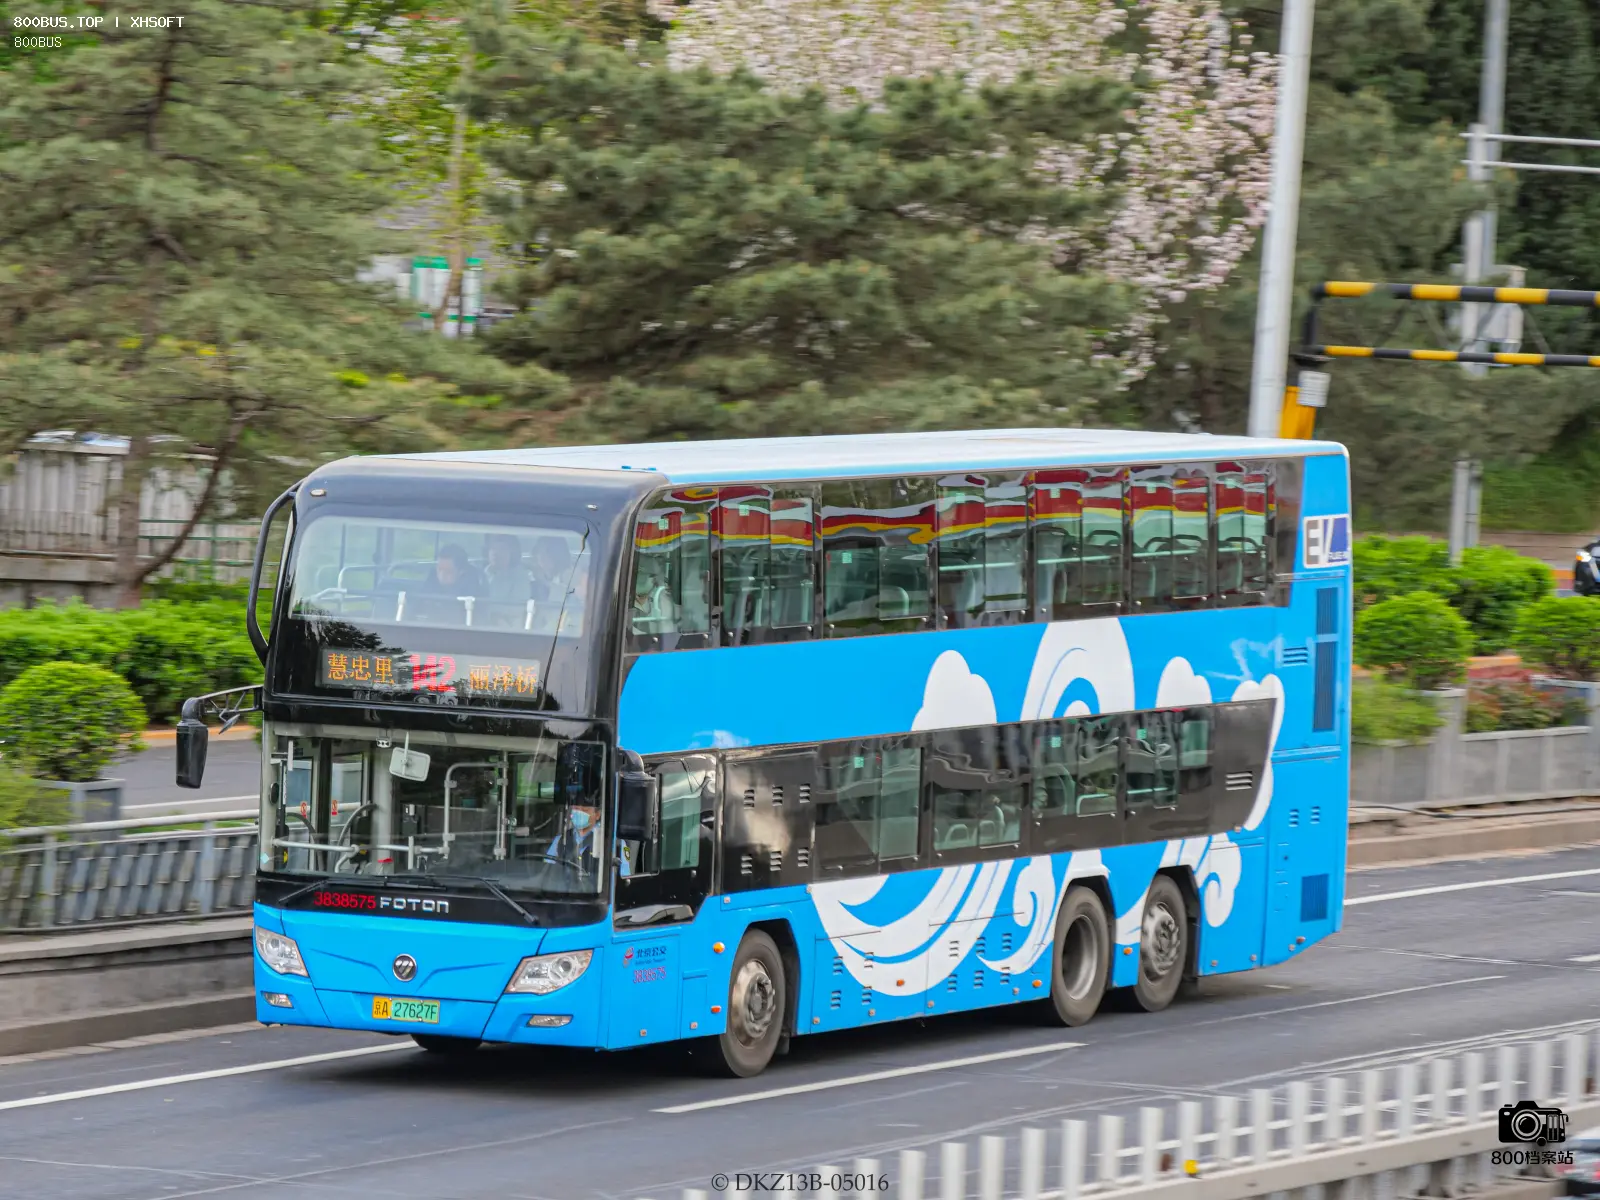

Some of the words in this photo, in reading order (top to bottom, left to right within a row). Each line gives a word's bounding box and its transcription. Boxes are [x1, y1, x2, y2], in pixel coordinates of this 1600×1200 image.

[327, 652, 395, 685] 慧忠里
[468, 663, 538, 695] 丽泽桥
[313, 891, 377, 910] 3838575
[379, 896, 450, 914] FOTON
